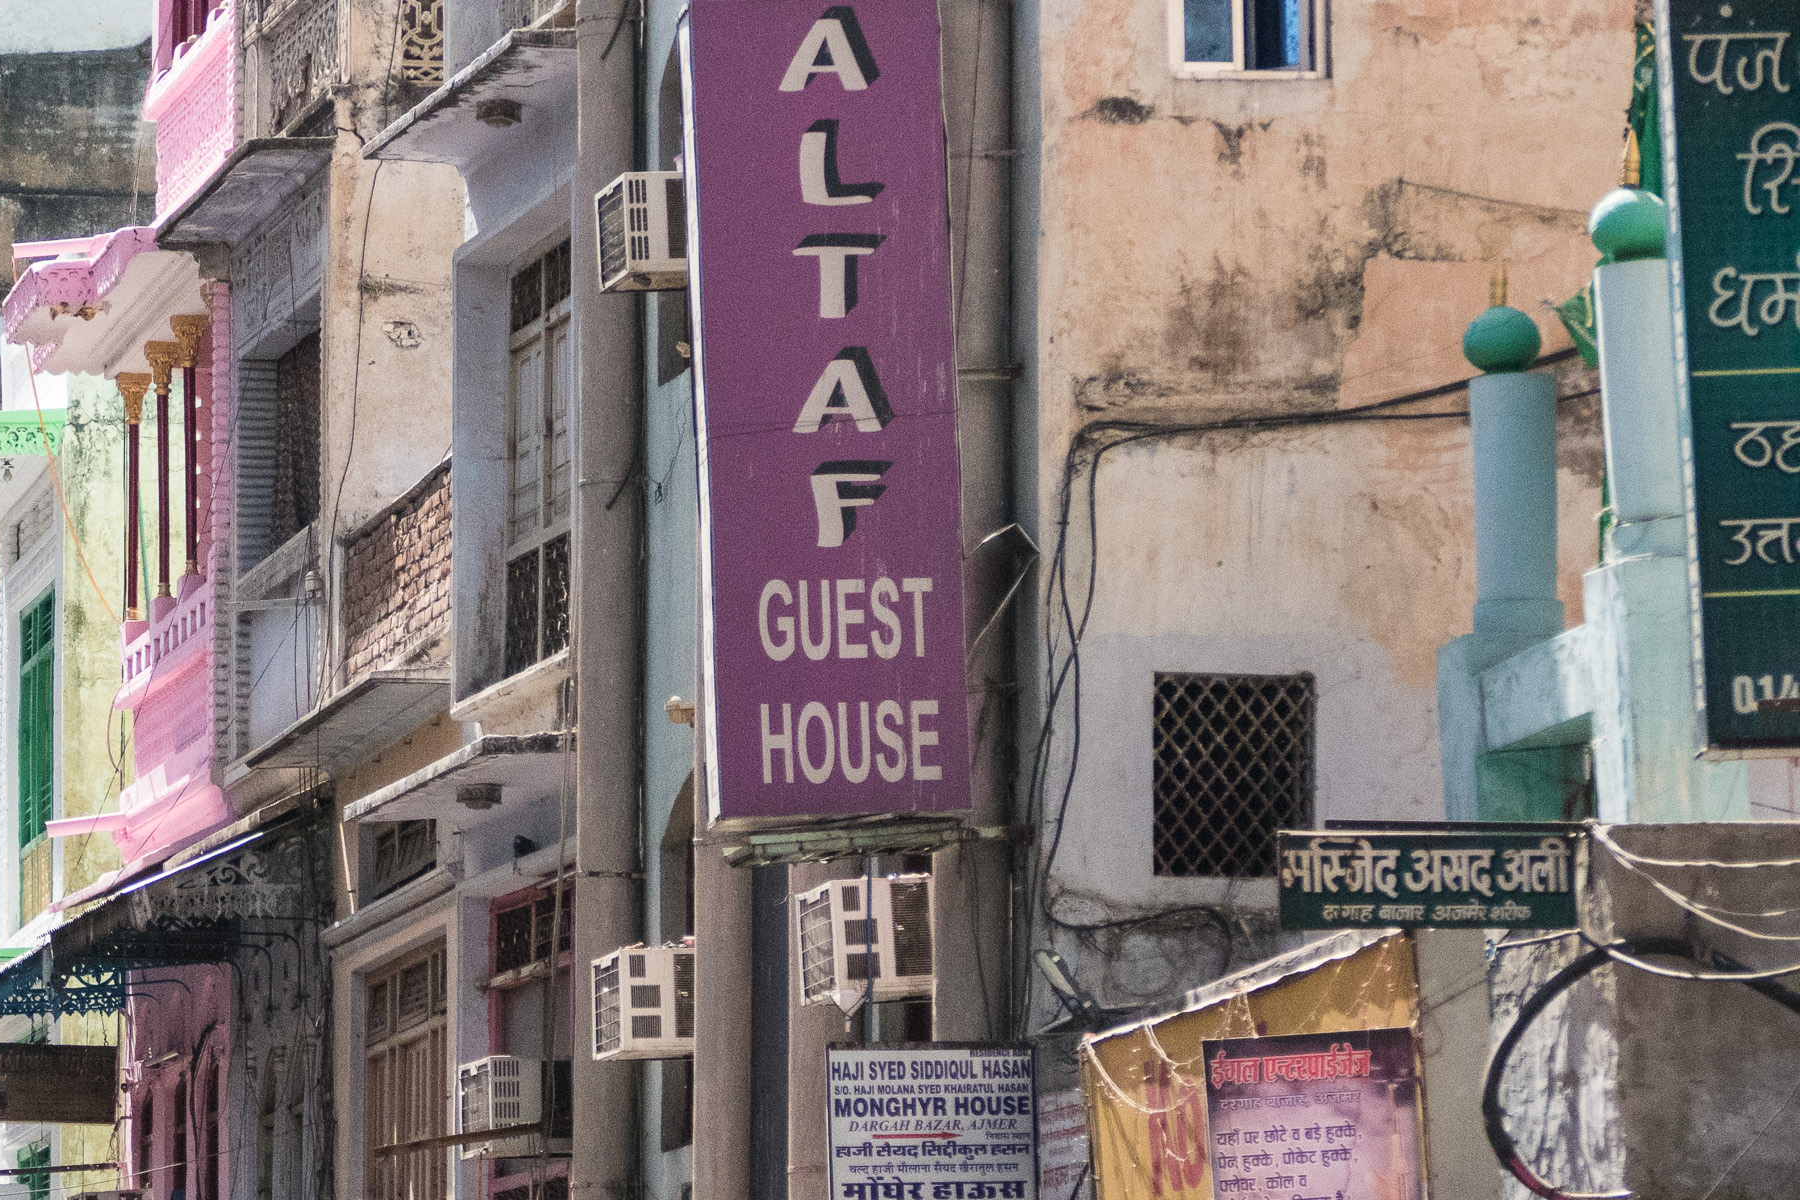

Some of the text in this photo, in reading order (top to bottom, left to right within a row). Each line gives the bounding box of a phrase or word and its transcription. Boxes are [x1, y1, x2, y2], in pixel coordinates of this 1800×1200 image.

[778, 5, 897, 549] ALTAF
[758, 577, 933, 663] GUEST
[761, 699, 943, 785] HOUSE
[1403, 848, 1496, 897] असद
[1498, 838, 1571, 893] अली
[831, 1059, 1031, 1081] HAJI SYED SIDDIQUL HASAN
[1210, 1050, 1261, 1089] ईगल
[854, 1085, 875, 1095] HAJI
[878, 1084, 915, 1095] MOLANA
[918, 1084, 941, 1094] SYED
[944, 1083, 995, 1094] KHAIRATUL
[998, 1083, 1029, 1093] HASAN
[834, 1096, 947, 1118] MONGHYR
[954, 1096, 1031, 1116] HOUSE
[849, 1120, 910, 1132] DARGAH
[970, 1119, 1017, 1131] AJMER
[1243, 1131, 1260, 1144] पर
[1264, 1125, 1287, 1143] छोटे
[1292, 1128, 1301, 1141] व
[931, 1180, 1027, 1200] हाऊस
[1266, 1172, 1294, 1189] कोल
[1298, 1174, 1307, 1187] व
